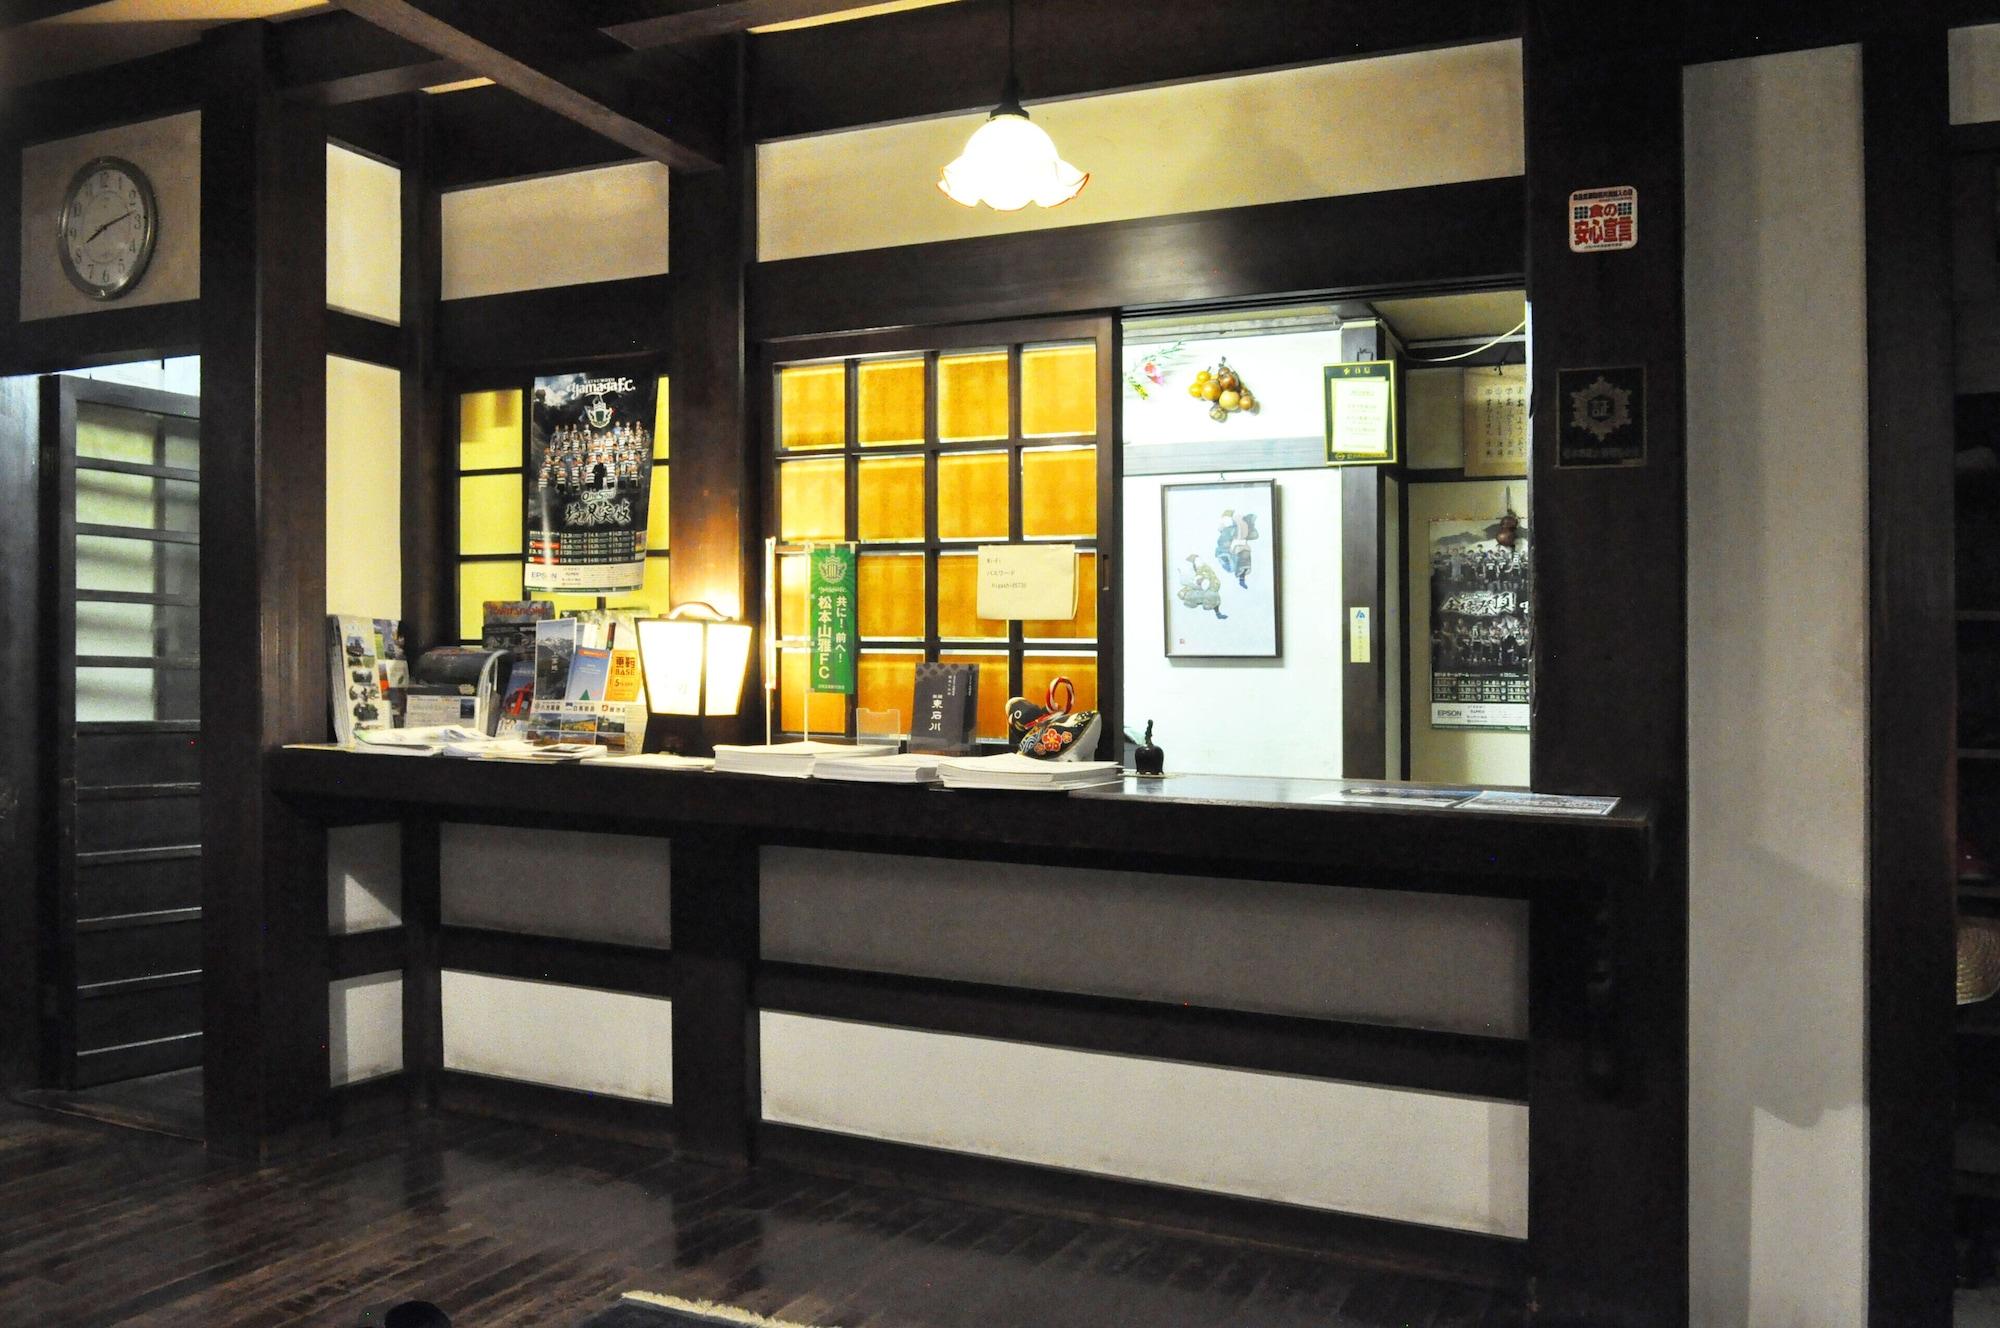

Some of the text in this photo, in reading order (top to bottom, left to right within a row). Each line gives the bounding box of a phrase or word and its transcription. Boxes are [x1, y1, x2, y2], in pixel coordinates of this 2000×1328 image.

[1574, 216, 1633, 245] 安心宣言
[531, 571, 558, 580] EPSN
[818, 595, 832, 680] 松本山雅FC
[928, 699, 944, 732] 東石川
[1437, 709, 1462, 718] EPSON
